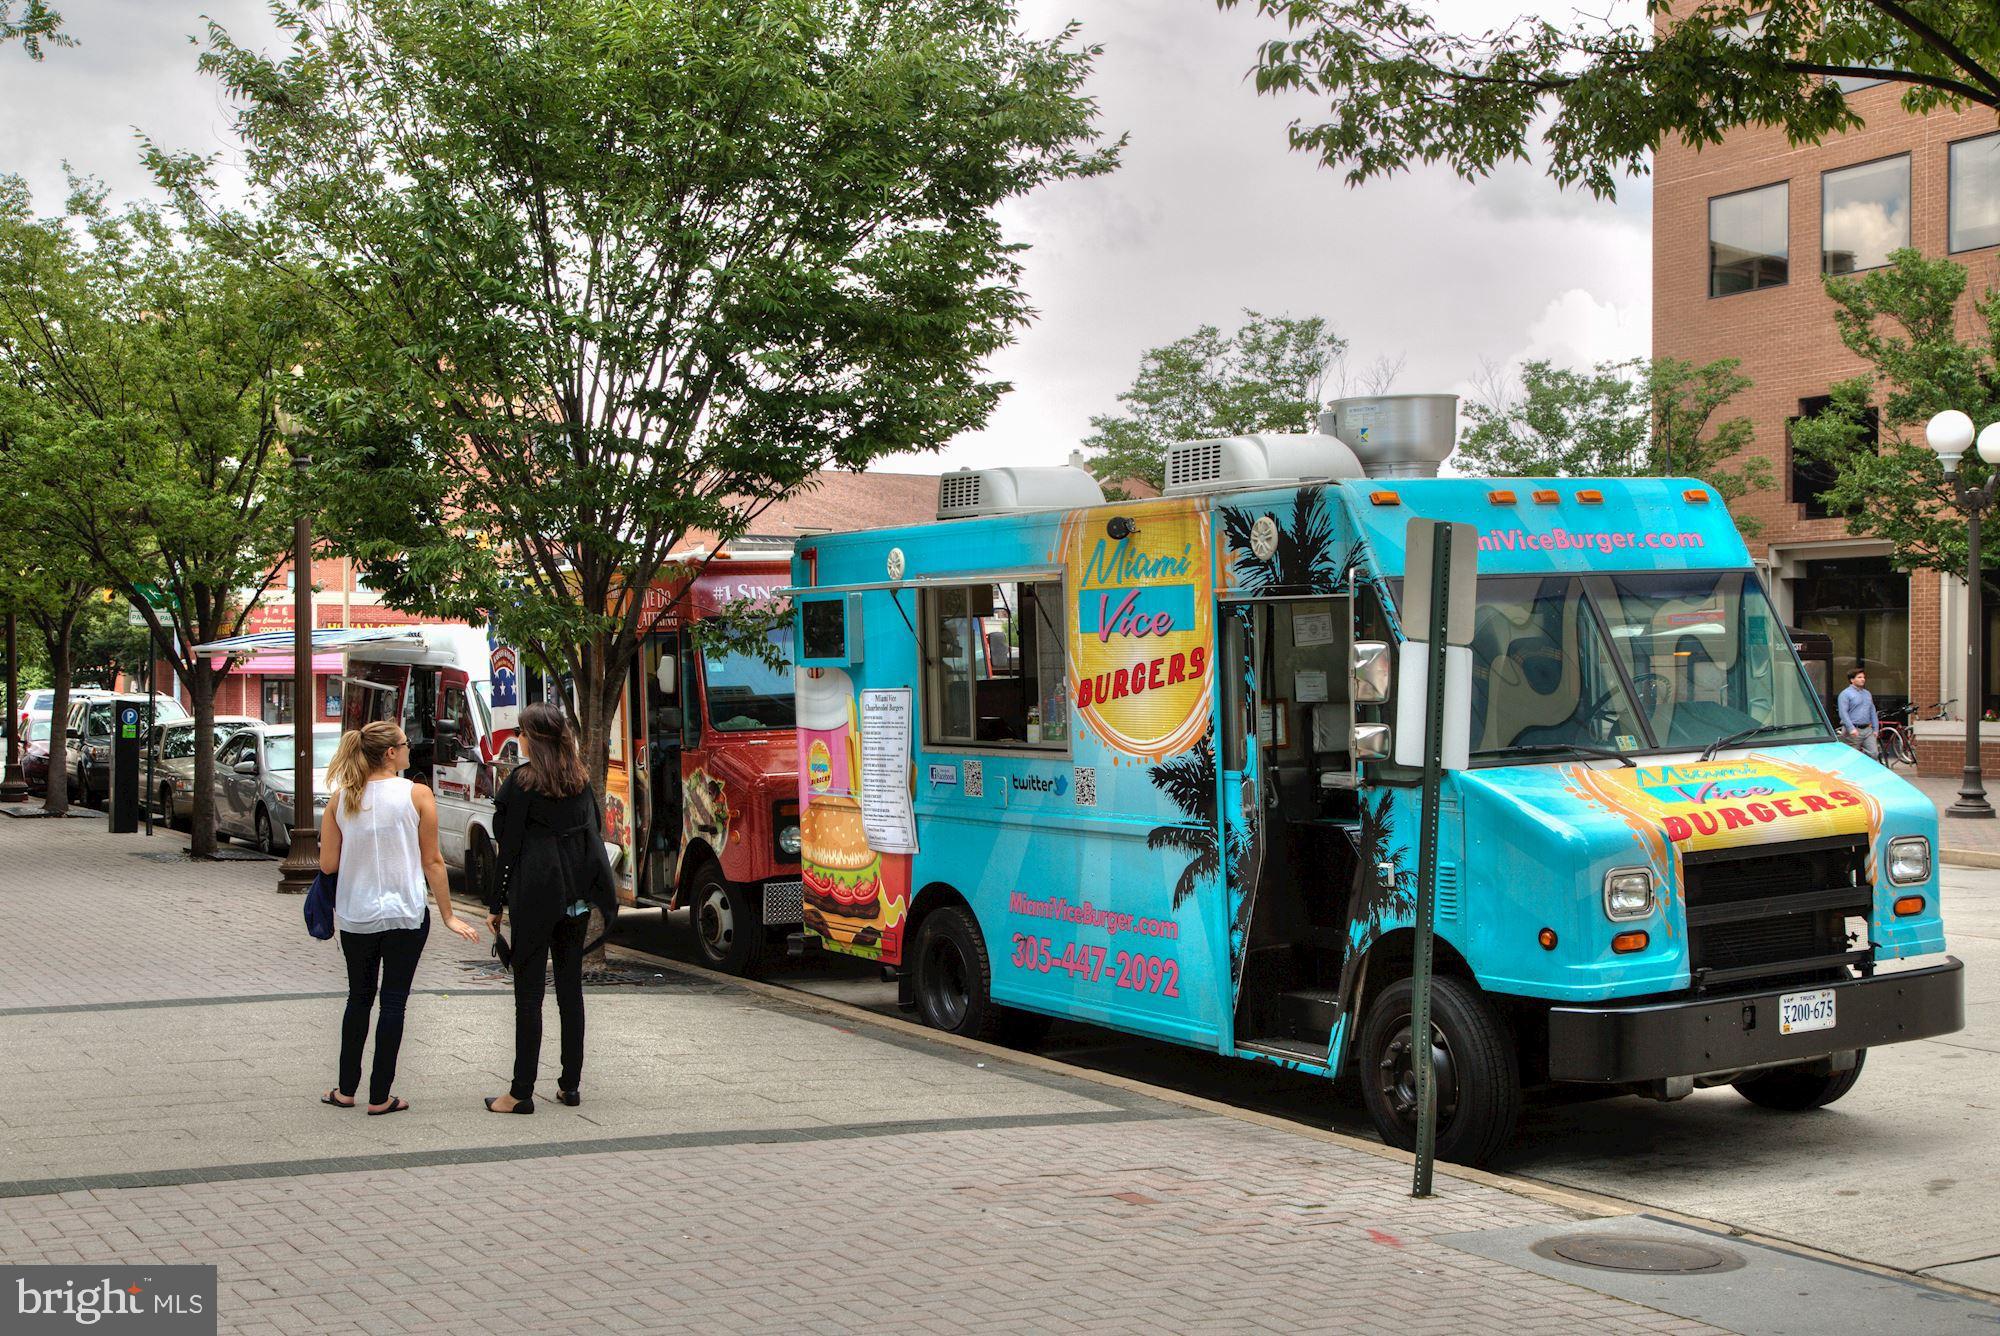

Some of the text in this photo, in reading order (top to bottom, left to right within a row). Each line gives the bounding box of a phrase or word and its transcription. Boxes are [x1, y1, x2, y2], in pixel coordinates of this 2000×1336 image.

[1081, 538, 1191, 587] Miami
[657, 588, 671, 608] DO
[1099, 589, 1175, 643] Vice
[1077, 646, 1205, 709] BURGERS
[1012, 774, 1054, 792] twitter
[1635, 763, 1758, 788] Miami
[1672, 781, 1775, 804] Vice
[1661, 790, 1861, 843] BURGERS
[1009, 890, 1178, 940] MiamiViceBurger.com
[1011, 932, 1180, 998] 305-447-2092
[1791, 1000, 1833, 1022] 200-675
